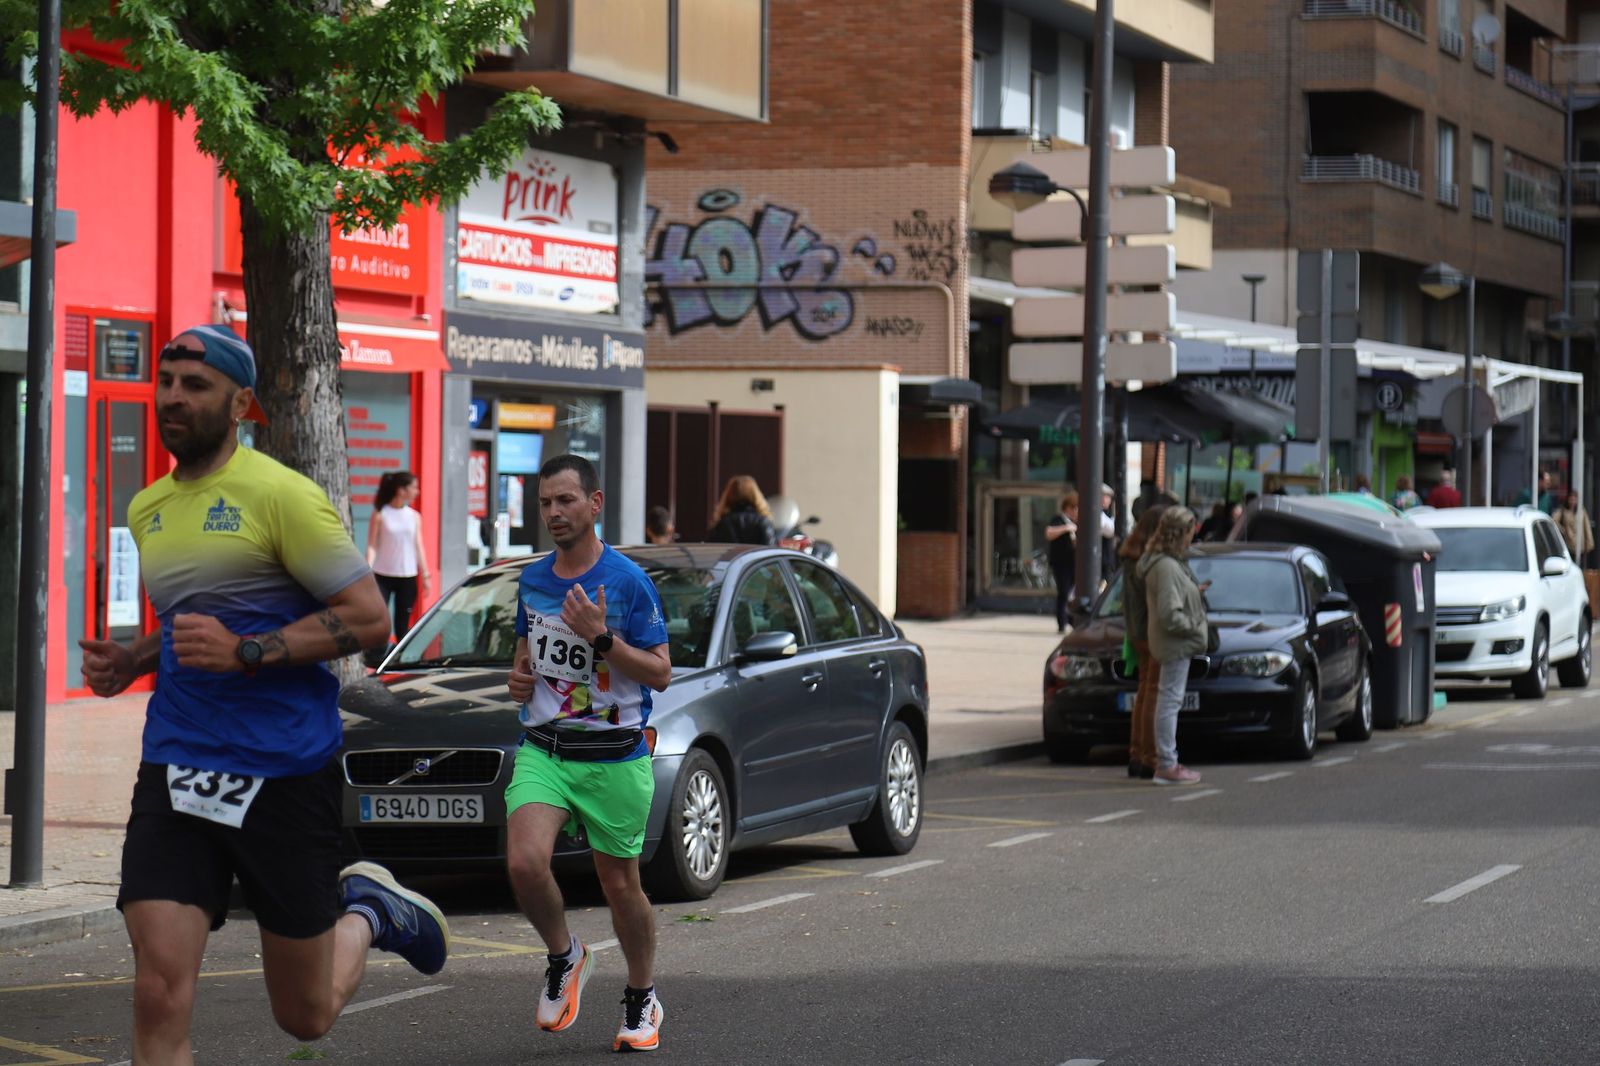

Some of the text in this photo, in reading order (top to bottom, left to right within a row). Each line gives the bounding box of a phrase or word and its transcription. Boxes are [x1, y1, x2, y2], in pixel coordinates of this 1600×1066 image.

[503, 168, 577, 221] prink
[350, 254, 410, 280] Auditivo
[457, 227, 617, 278] CARTUCHOS IMPRESORAS
[448, 325, 533, 369] Reparamos
[541, 334, 599, 370] Móviles
[203, 521, 240, 532] DUERO
[551, 625, 573, 637] CASTILLA
[536, 634, 587, 671] 136
[170, 765, 255, 808] 232
[375, 797, 478, 819] 6940 DGS
